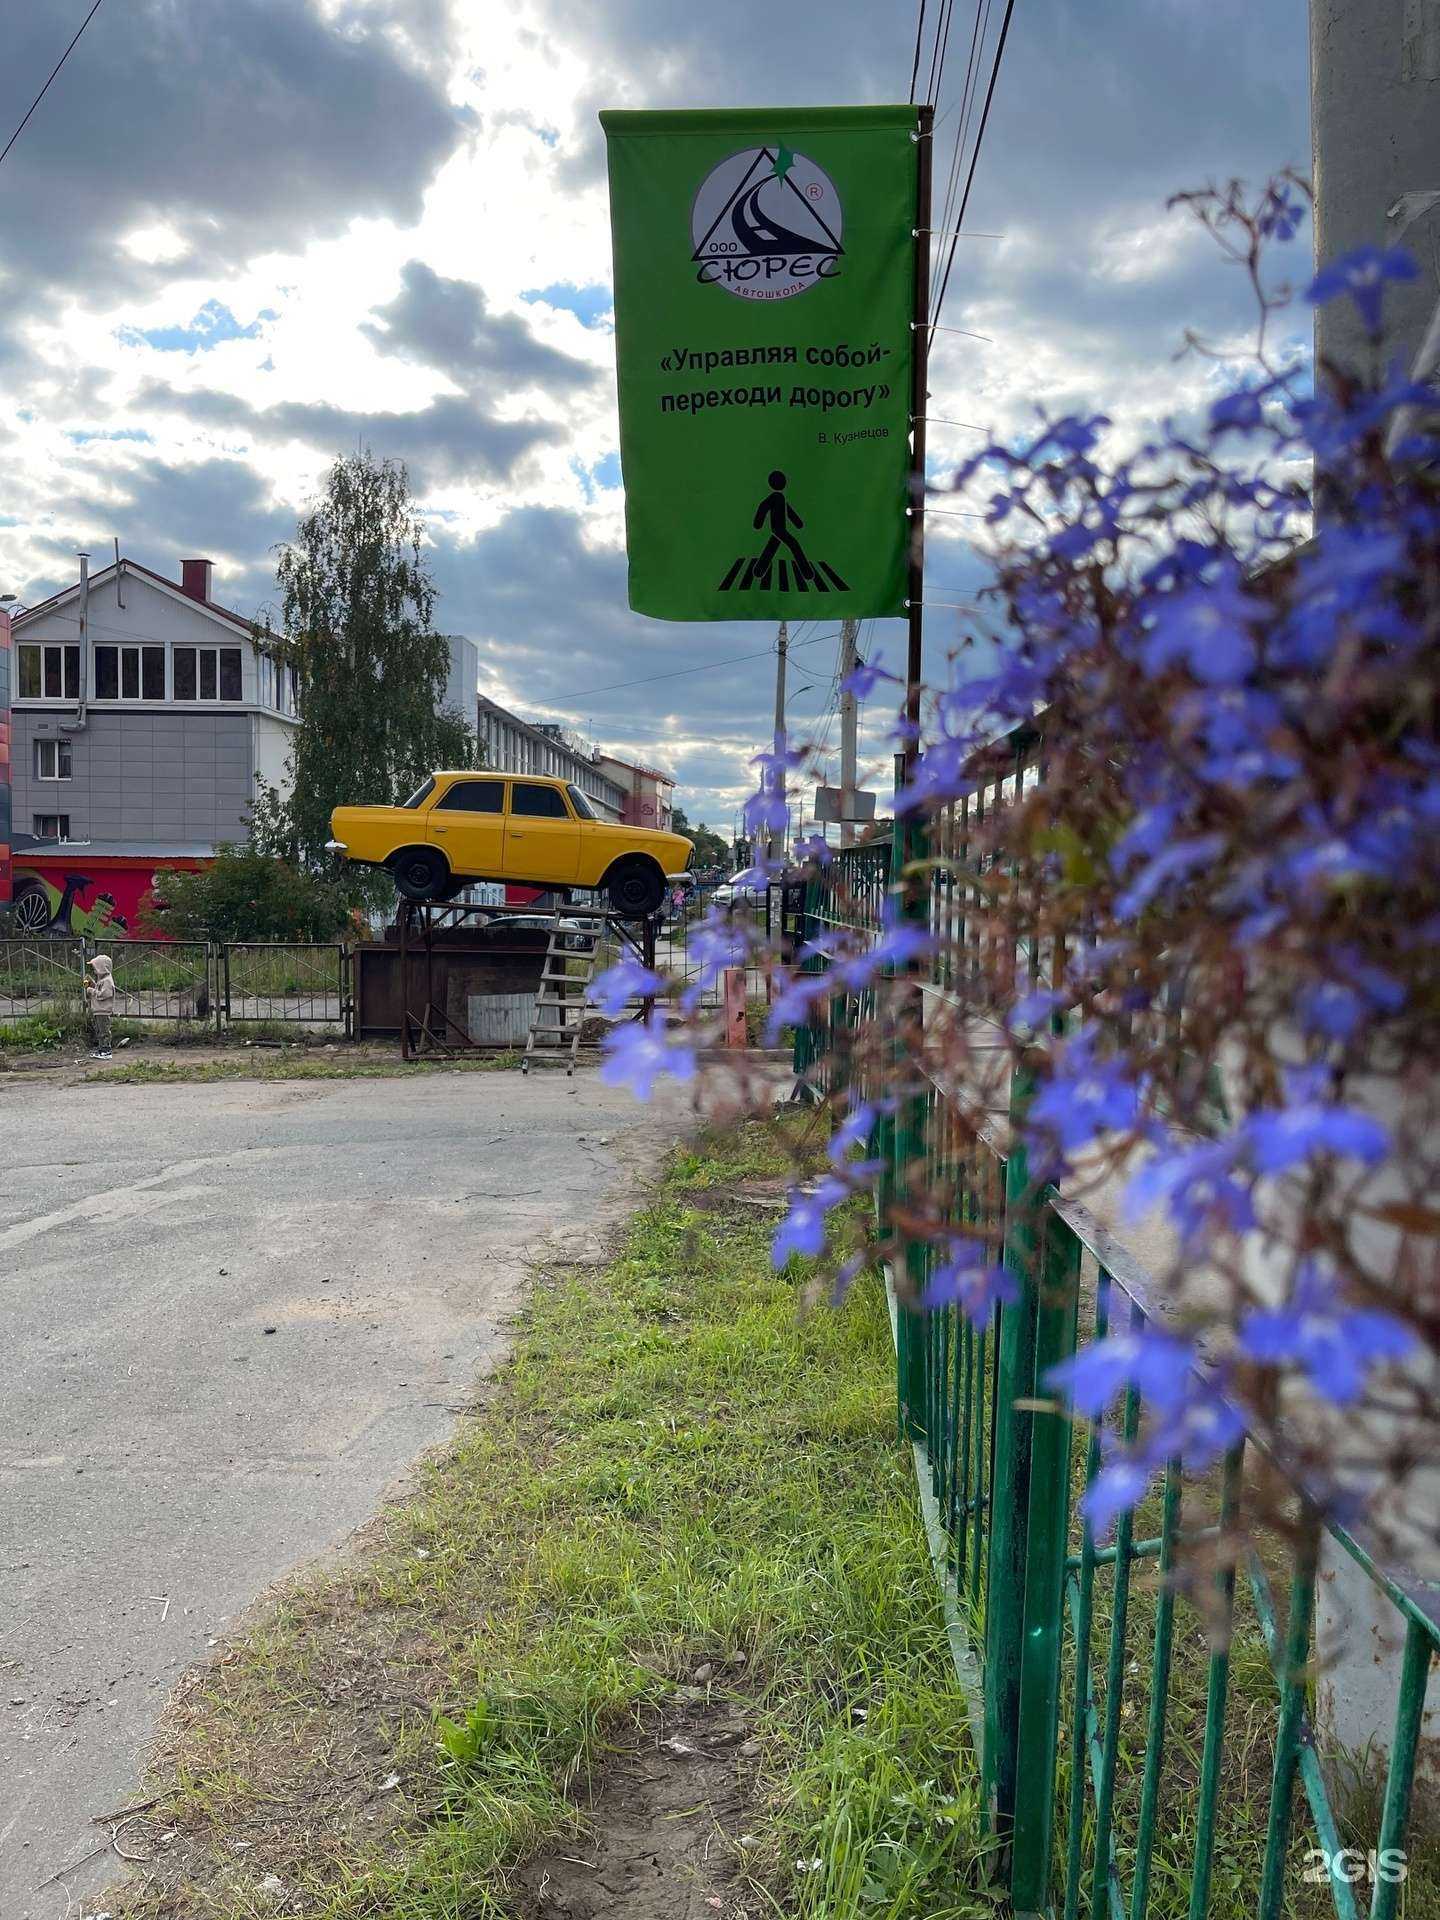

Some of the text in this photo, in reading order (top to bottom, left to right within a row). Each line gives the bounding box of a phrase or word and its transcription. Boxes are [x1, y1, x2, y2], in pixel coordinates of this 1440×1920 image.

[696, 255, 842, 284] СЮРЕС
[734, 281, 806, 299] АВТОШКОЛА
[660, 342, 891, 374] «Управляя собой-
[661, 383, 891, 415] переходи дорогу»
[818, 426, 890, 446] В. Кузнецов
